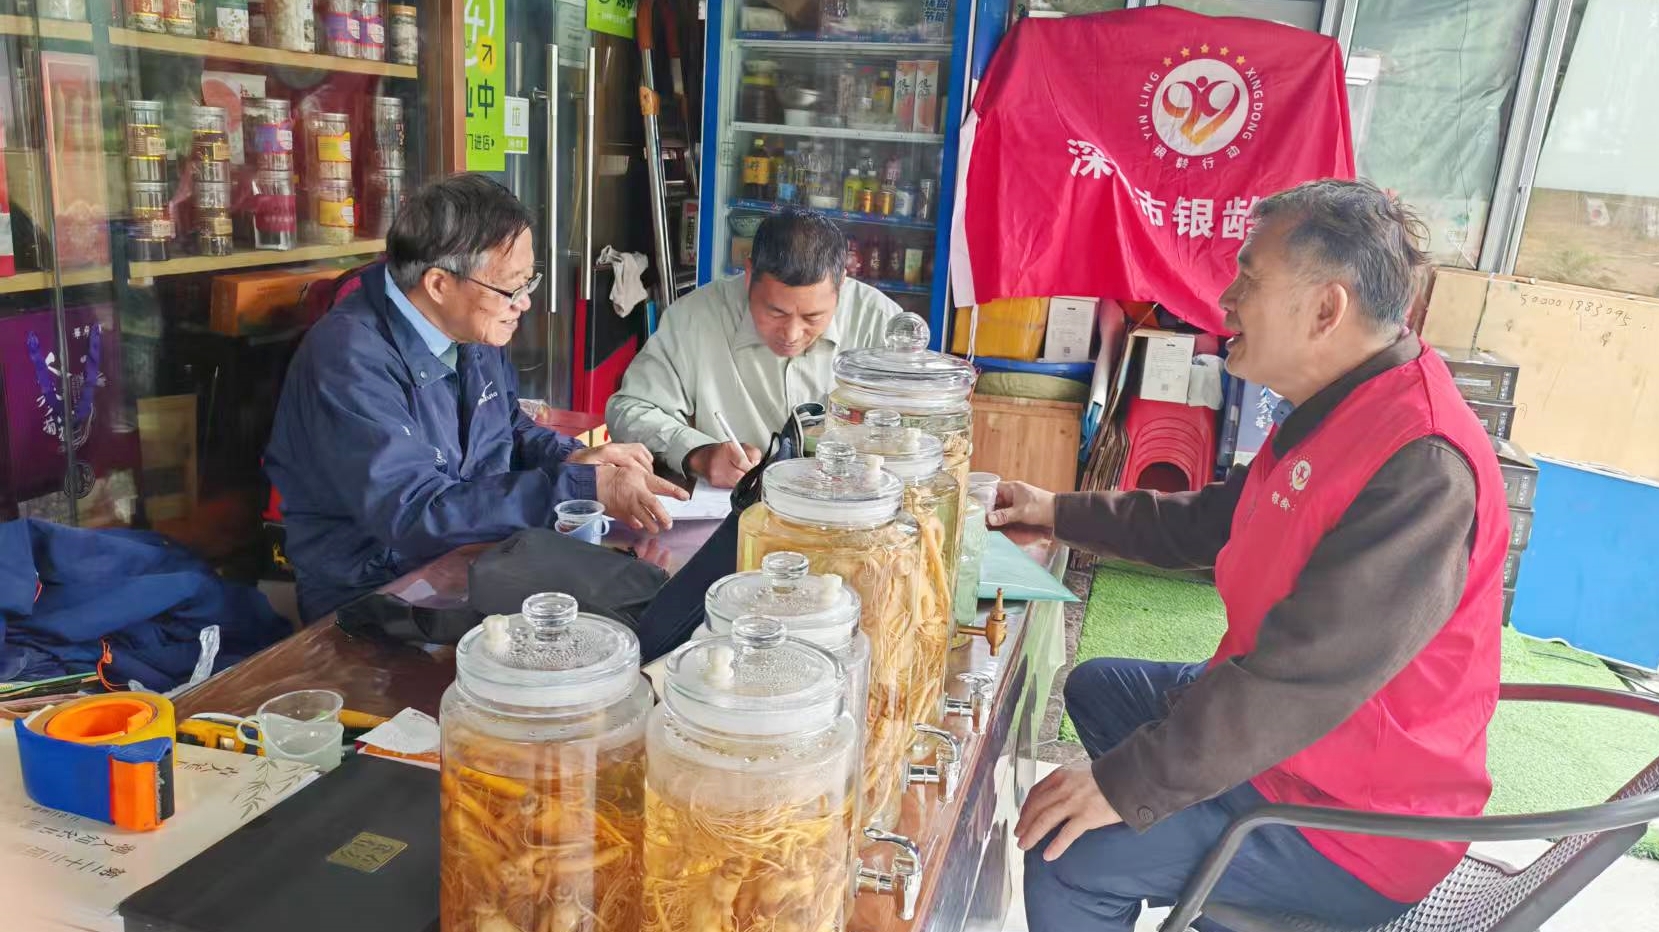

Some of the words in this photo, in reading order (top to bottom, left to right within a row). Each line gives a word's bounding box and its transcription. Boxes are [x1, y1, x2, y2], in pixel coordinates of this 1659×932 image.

[1139, 71, 1160, 107] LING
[1244, 66, 1263, 99] XING
[1138, 114, 1153, 140] YIN
[1242, 102, 1263, 140] DONG
[1153, 143, 1240, 170] 银龄行动
[1067, 138, 1261, 241] 深市银龄
